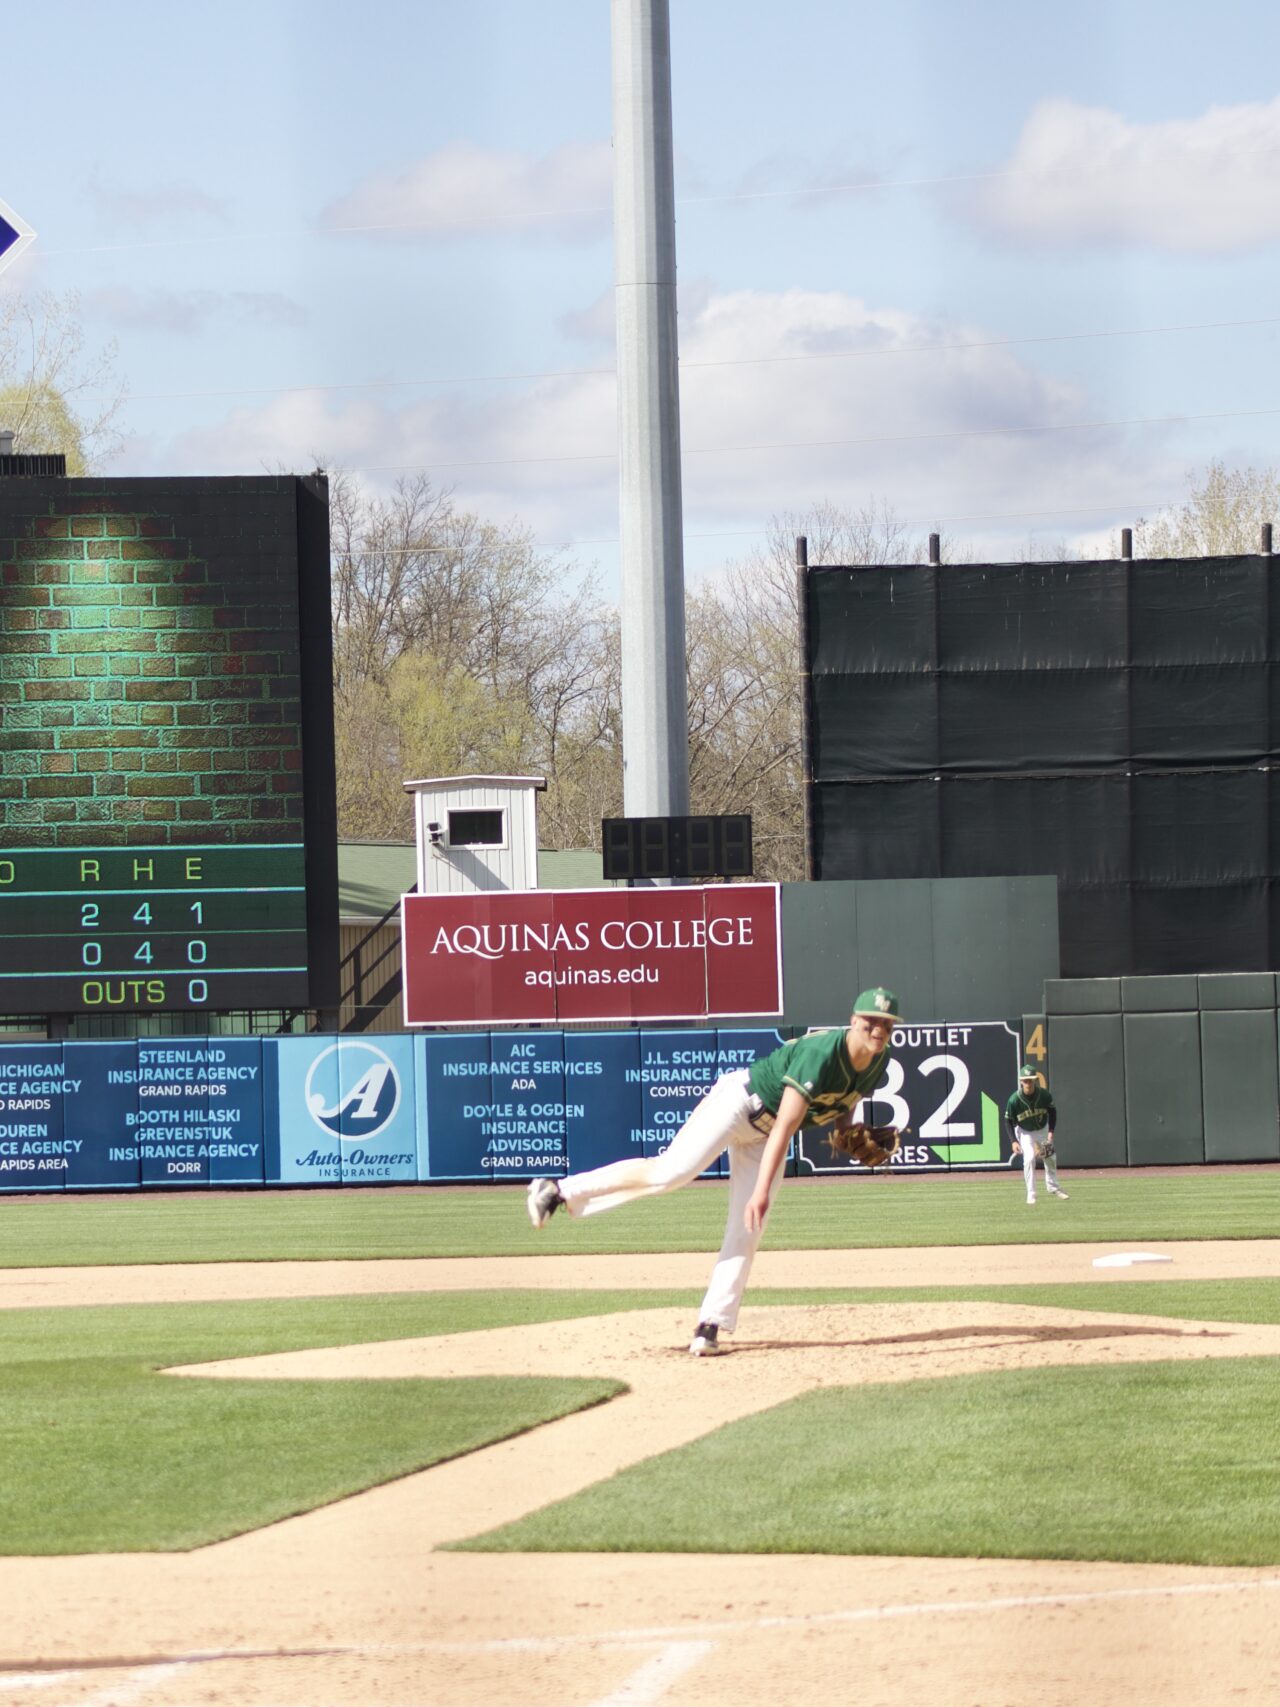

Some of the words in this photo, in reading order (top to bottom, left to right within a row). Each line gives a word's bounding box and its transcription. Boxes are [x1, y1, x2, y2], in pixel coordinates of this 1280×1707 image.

[81, 860, 100, 882] R
[133, 859, 153, 881] H
[186, 858, 203, 880] E
[81, 904, 99, 927] 2
[133, 903, 153, 925] 4
[190, 902, 203, 924] 1
[430, 922, 590, 960] AQUINAS
[600, 917, 754, 950] COLLEGE
[83, 943, 102, 965] 0
[134, 942, 154, 964] 4
[188, 940, 207, 963] 0
[524, 964, 659, 989] aquinas.edu
[83, 981, 166, 1005] OUTS
[189, 979, 208, 1003] 0
[139, 1050, 225, 1064] STEENLAND
[510, 1044, 536, 1057] AIC
[644, 1052, 669, 1065] J.L.
[672, 1050, 756, 1064] SCHWARTZ
[108, 1067, 193, 1083] INSURANCE
[197, 1066, 258, 1080] AGENCY
[443, 1061, 529, 1076] INSURANCE
[533, 1061, 603, 1075] SERVICES
[625, 1068, 711, 1082] INSURANCE
[20, 1080, 81, 1094] AGENCY
[139, 1085, 182, 1096] GRAND
[185, 1085, 227, 1096] RAPIDS
[511, 1079, 536, 1090] ADA
[650, 1085, 712, 1098] COMSTOC
[8, 1099, 51, 1110] RAPIDS
[463, 1104, 513, 1118] DOYLE
[517, 1104, 527, 1117] &
[530, 1104, 585, 1117] OGDEN
[125, 1110, 179, 1126] BOOTH
[183, 1109, 240, 1123] HILASKI
[134, 1127, 233, 1142] GREVENSTUK
[481, 1121, 567, 1135] INSURANCE
[21, 1140, 83, 1154] AGENCY
[487, 1138, 562, 1152] ADVISORS
[109, 1145, 195, 1161] INSURANCE
[197, 1144, 259, 1158] AGENCY
[296, 1149, 414, 1166] Auto-Owners
[37, 1158, 69, 1170] AREA
[167, 1162, 201, 1174] DORR
[481, 1156, 523, 1167] GRAND
[526, 1156, 570, 1168] RAPIDS
[319, 1168, 391, 1177] INSURANCE
